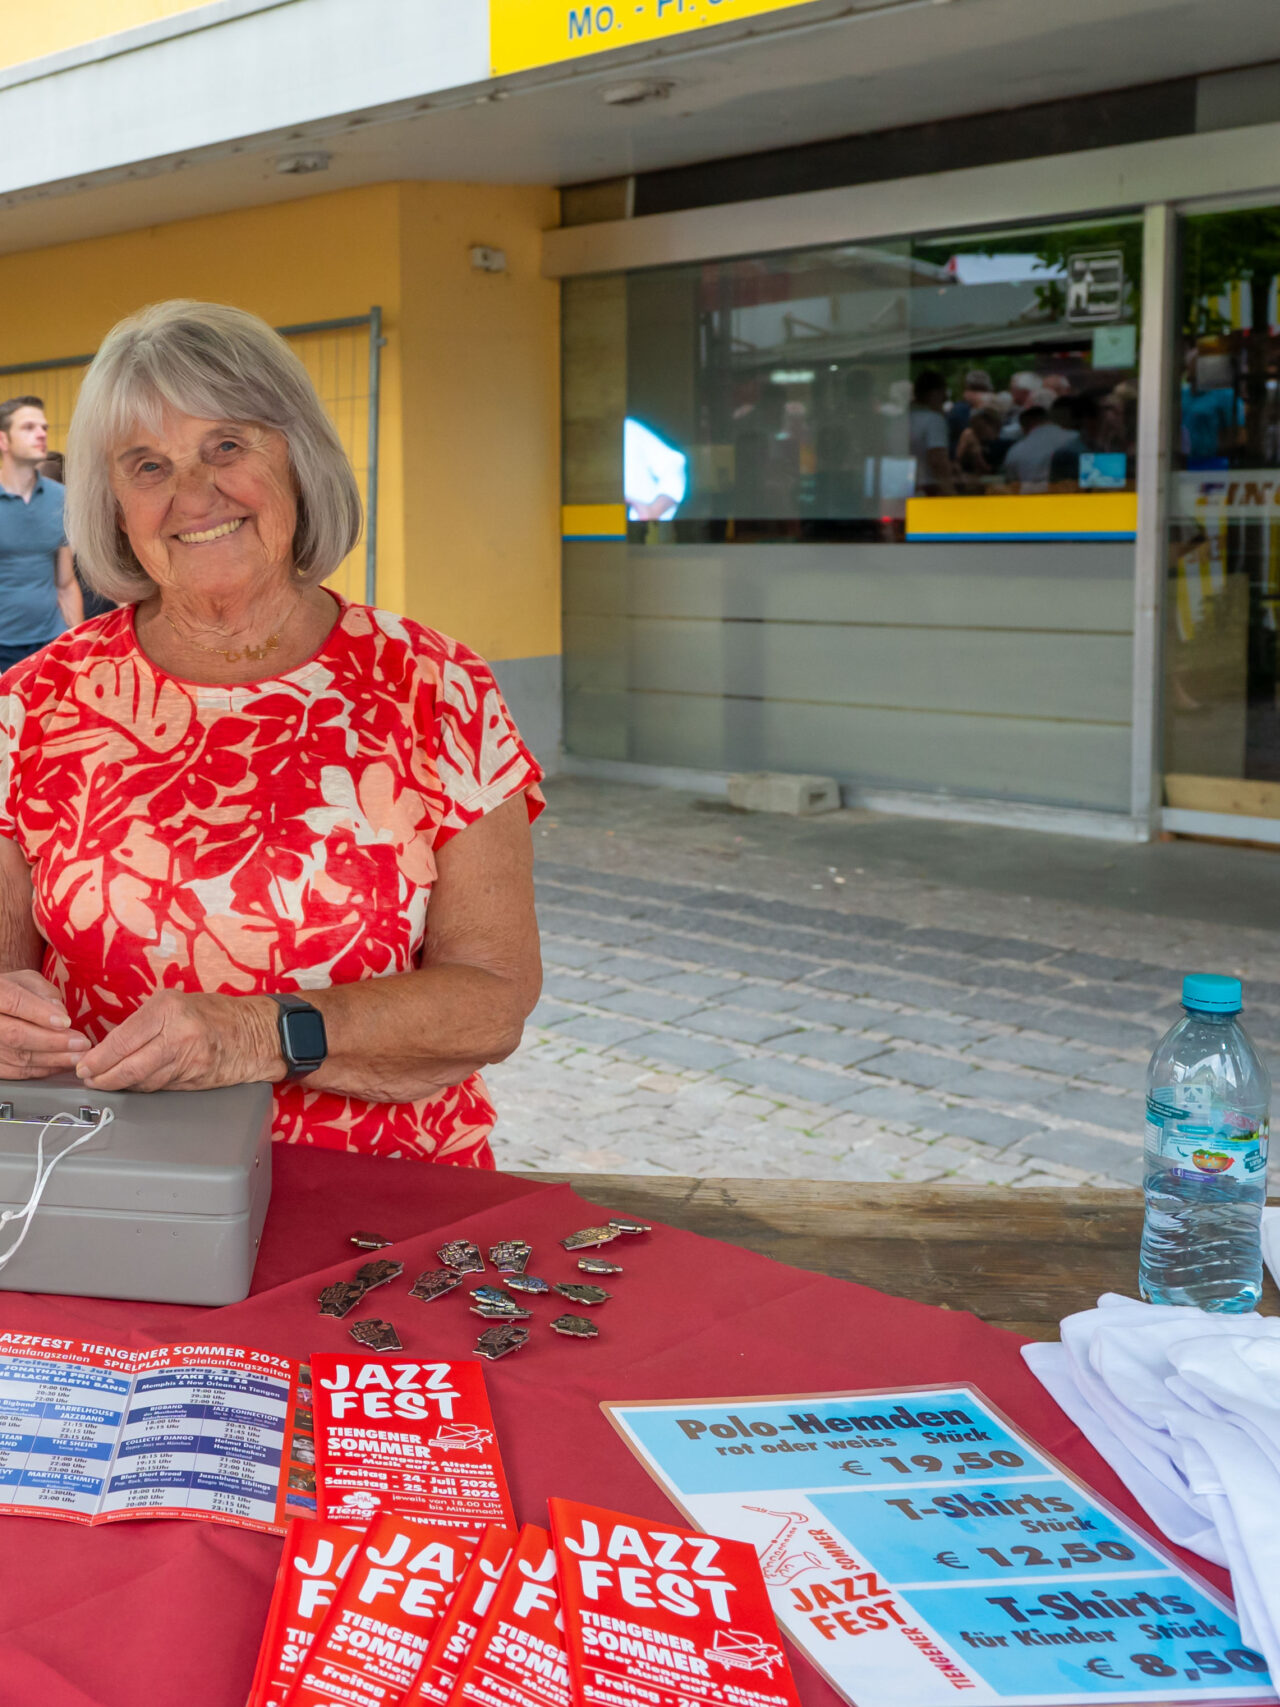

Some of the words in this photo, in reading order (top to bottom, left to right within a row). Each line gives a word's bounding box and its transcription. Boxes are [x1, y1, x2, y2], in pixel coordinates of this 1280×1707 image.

[81, 1343, 169, 1362] TIENGENER
[173, 1346, 246, 1359] SOMMER
[250, 1352, 291, 1369] 2026
[104, 1358, 171, 1372] SPIELPLAN
[182, 1357, 292, 1380] Spielanfangszeiten
[16, 1372, 51, 1381] BLACK
[54, 1377, 90, 1386] EARTH
[93, 1382, 127, 1392] BAND
[141, 1380, 176, 1390] Memphis
[206, 1381, 237, 1389] Orleans
[248, 1387, 280, 1398] Tiengen
[320, 1363, 454, 1391] JAZZ
[54, 1404, 115, 1417] BARRELHOUSE
[60, 1412, 104, 1422] JAZZBAND
[231, 1408, 279, 1422] CONNECTION
[330, 1391, 462, 1420] FEST
[327, 1426, 422, 1444] TIENGENER
[675, 1405, 974, 1441] Polo-Hemden
[67, 1440, 98, 1448] SHEIKS
[126, 1436, 162, 1446] COLLECTIF
[213, 1443, 266, 1458] Heartbreakers
[214, 1438, 241, 1447] Helmut
[327, 1438, 432, 1459] SOMMER
[716, 1444, 755, 1456] rot
[761, 1439, 818, 1454] oder
[823, 1435, 897, 1450] weiss
[922, 1428, 992, 1445] Stück
[839, 1460, 872, 1475] €
[880, 1449, 1025, 1475] 19,50
[27, 1471, 61, 1479] MARTIN
[63, 1474, 100, 1485] SCHMITT
[324, 1477, 389, 1489] Samstag
[404, 1483, 427, 1492] 25.
[431, 1486, 458, 1496] Juli
[462, 1488, 500, 1499] 2026
[335, 1467, 388, 1480] Freitag
[402, 1474, 426, 1483] 24.
[430, 1478, 456, 1486] Juli
[459, 1479, 498, 1489] 2026
[884, 1492, 1075, 1521] T-Shirts
[1021, 1516, 1099, 1534] Stück
[564, 1519, 726, 1577] JAZZ
[808, 1528, 861, 1571] SOMMER
[933, 1551, 970, 1569] €
[977, 1541, 1136, 1568] 12,50
[578, 1560, 737, 1623] FEST
[790, 1572, 892, 1612] JAZZ
[809, 1600, 908, 1640] FEST
[985, 1590, 1196, 1622] T-Shirts
[341, 1609, 429, 1652] TIENGEN
[579, 1610, 697, 1654] TIENGENER
[960, 1631, 1010, 1648] für
[1011, 1626, 1118, 1646] Kinder
[1138, 1619, 1225, 1640] Stück
[581, 1626, 711, 1678] SOMMER
[900, 1627, 977, 1691] TIENGENER
[1084, 1657, 1125, 1678] €
[1130, 1649, 1270, 1681] 8,50
[604, 1651, 632, 1665] der
[636, 1659, 719, 1689] Tiengener
[723, 1684, 789, 1706] Altstadt
